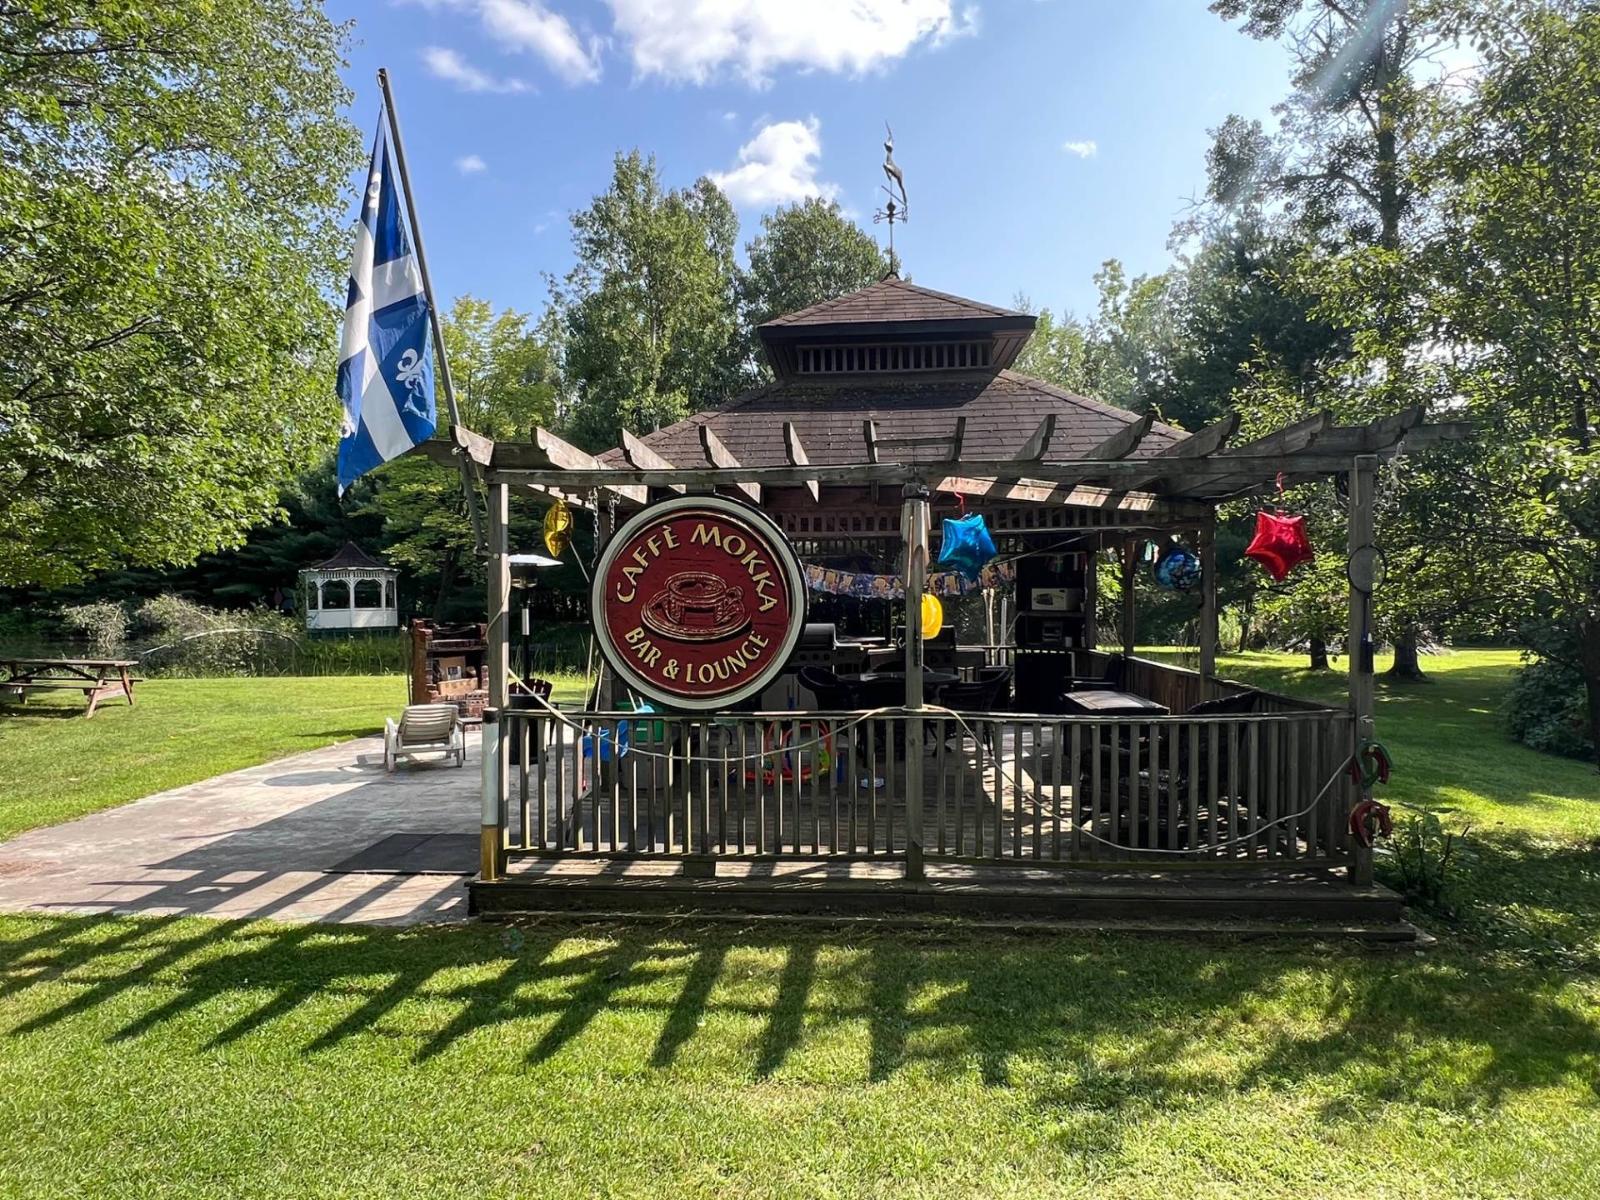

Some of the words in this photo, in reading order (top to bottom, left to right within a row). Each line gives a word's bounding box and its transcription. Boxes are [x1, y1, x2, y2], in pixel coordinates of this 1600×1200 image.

[616, 525, 680, 603] CAFFÈ
[690, 523, 778, 612] MOKKA
[624, 627, 662, 668] BAR
[662, 658, 679, 680] &
[685, 630, 769, 684] LOUNGE
